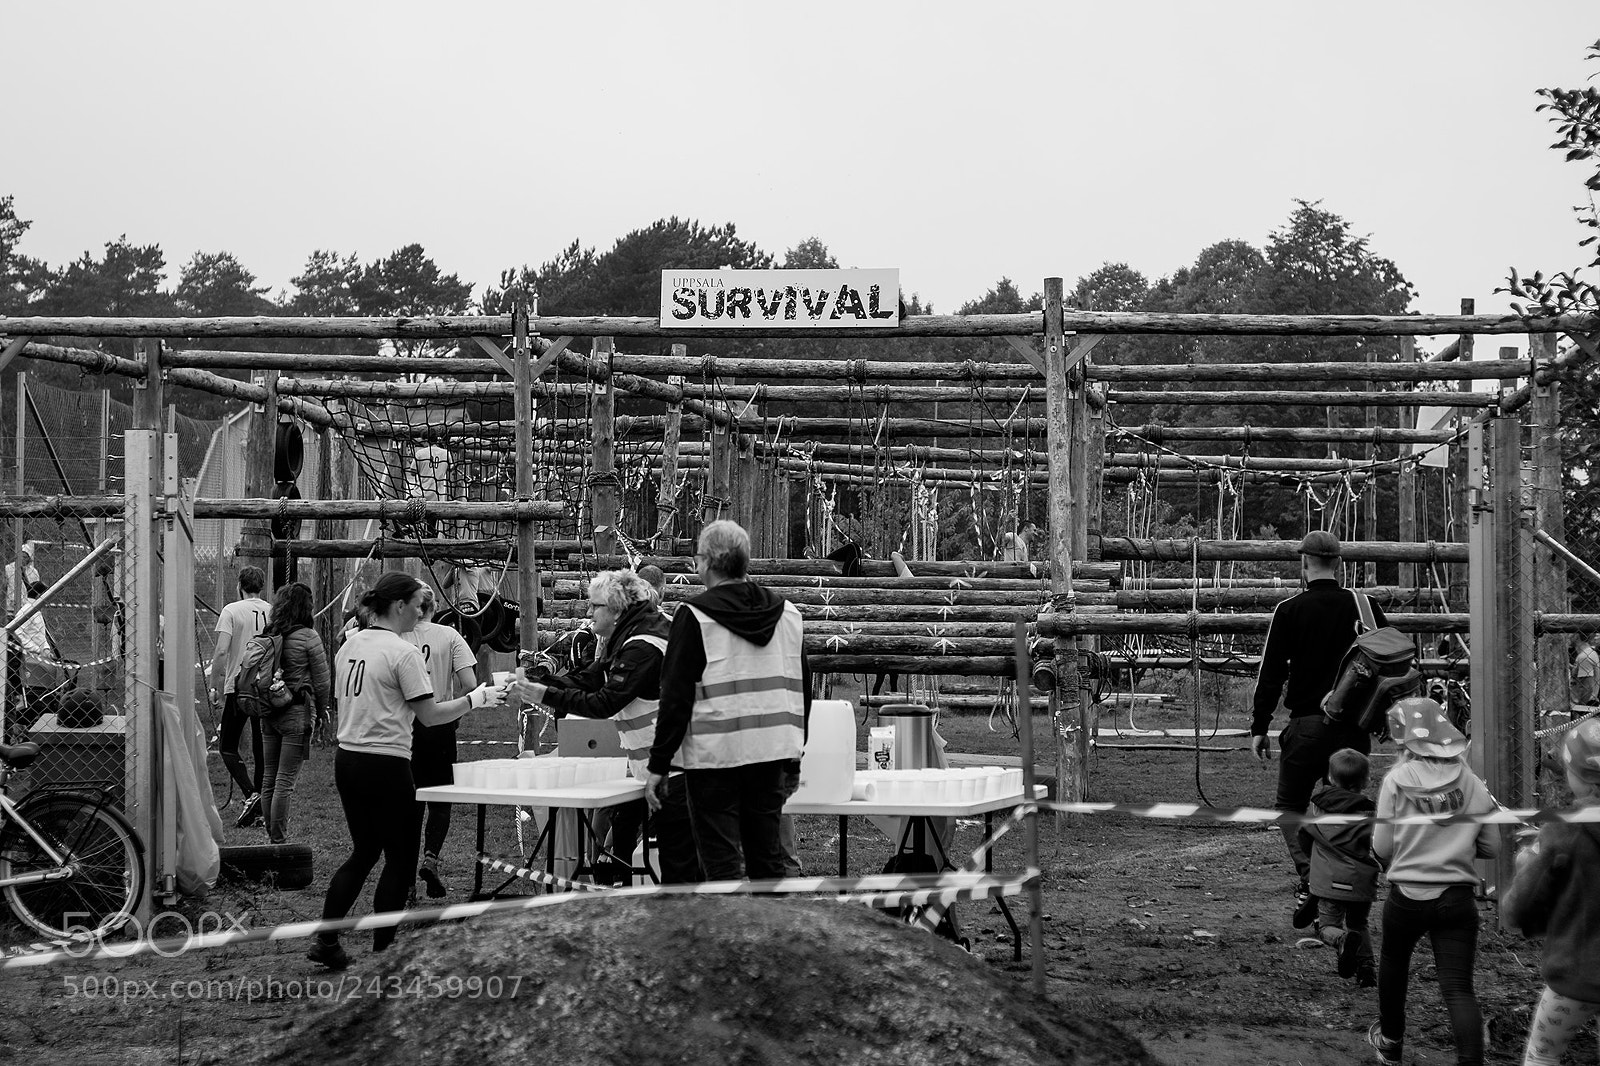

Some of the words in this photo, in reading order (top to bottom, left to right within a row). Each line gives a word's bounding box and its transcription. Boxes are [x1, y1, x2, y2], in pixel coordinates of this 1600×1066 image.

[672, 277, 724, 288] UPPSALA
[672, 284, 894, 321] SURVIVAL
[252, 610, 267, 631] 71
[345, 659, 366, 697] 70
